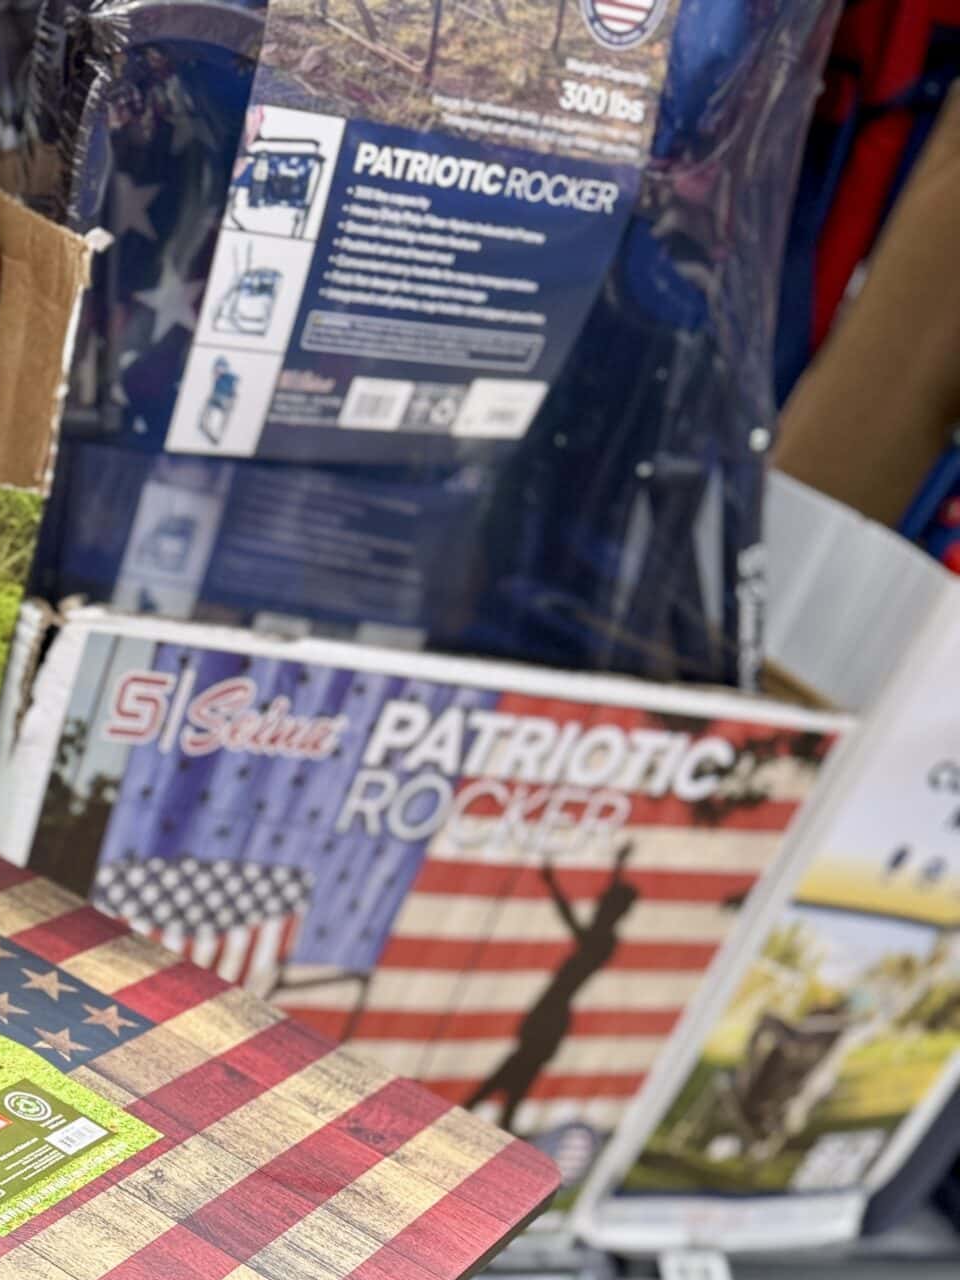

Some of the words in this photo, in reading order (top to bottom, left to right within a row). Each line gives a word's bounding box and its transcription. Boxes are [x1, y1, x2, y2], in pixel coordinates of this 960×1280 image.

[559, 80, 607, 115] 300
[608, 90, 646, 123] lbs
[353, 142, 506, 196] PATRIOTIC
[504, 167, 620, 215] ROCKER
[363, 699, 735, 802] PATRIOTIC
[336, 767, 633, 852] ROCKER
